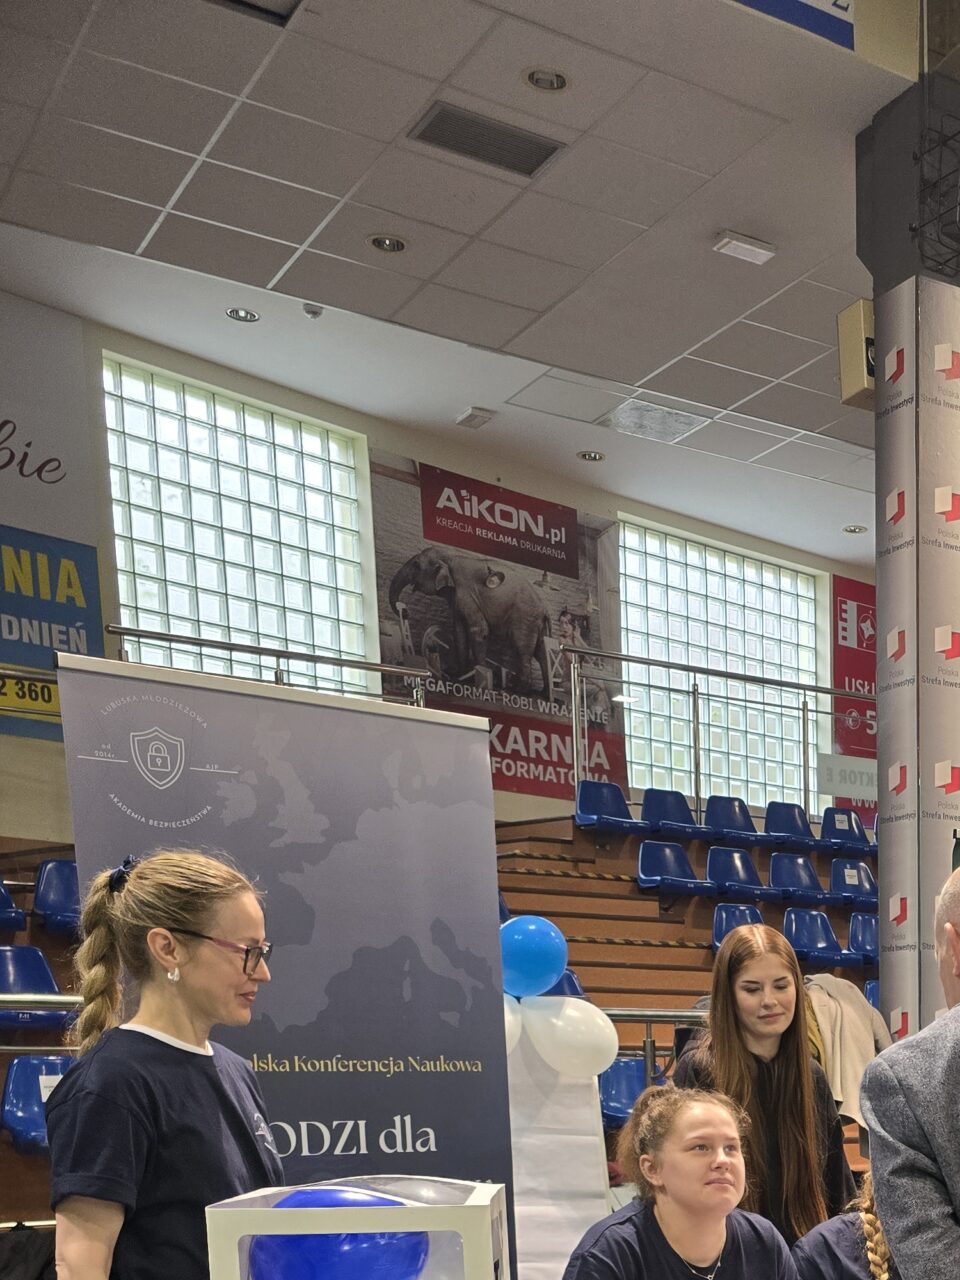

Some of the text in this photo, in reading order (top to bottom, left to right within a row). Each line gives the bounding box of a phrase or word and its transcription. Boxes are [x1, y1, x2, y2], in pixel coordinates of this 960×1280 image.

[920, 393, 942, 407] Strefa
[436, 516, 567, 561] KREACJA REKLAMA DRUKARNIA
[921, 535, 942, 548] Strefa
[921, 675, 942, 686] Strefa
[937, 665, 959, 677] Polska
[15, 679, 52, 704] 360
[502, 690, 534, 711] ROBI
[101, 694, 139, 716] LUBUSKA
[108, 792, 147, 824] AKADEMIA
[921, 810, 942, 822] Strefa
[937, 800, 959, 811] Polska
[294, 1054, 405, 1078] Konferencja
[407, 1054, 483, 1074] Naukowa
[378, 1114, 438, 1154] dla
